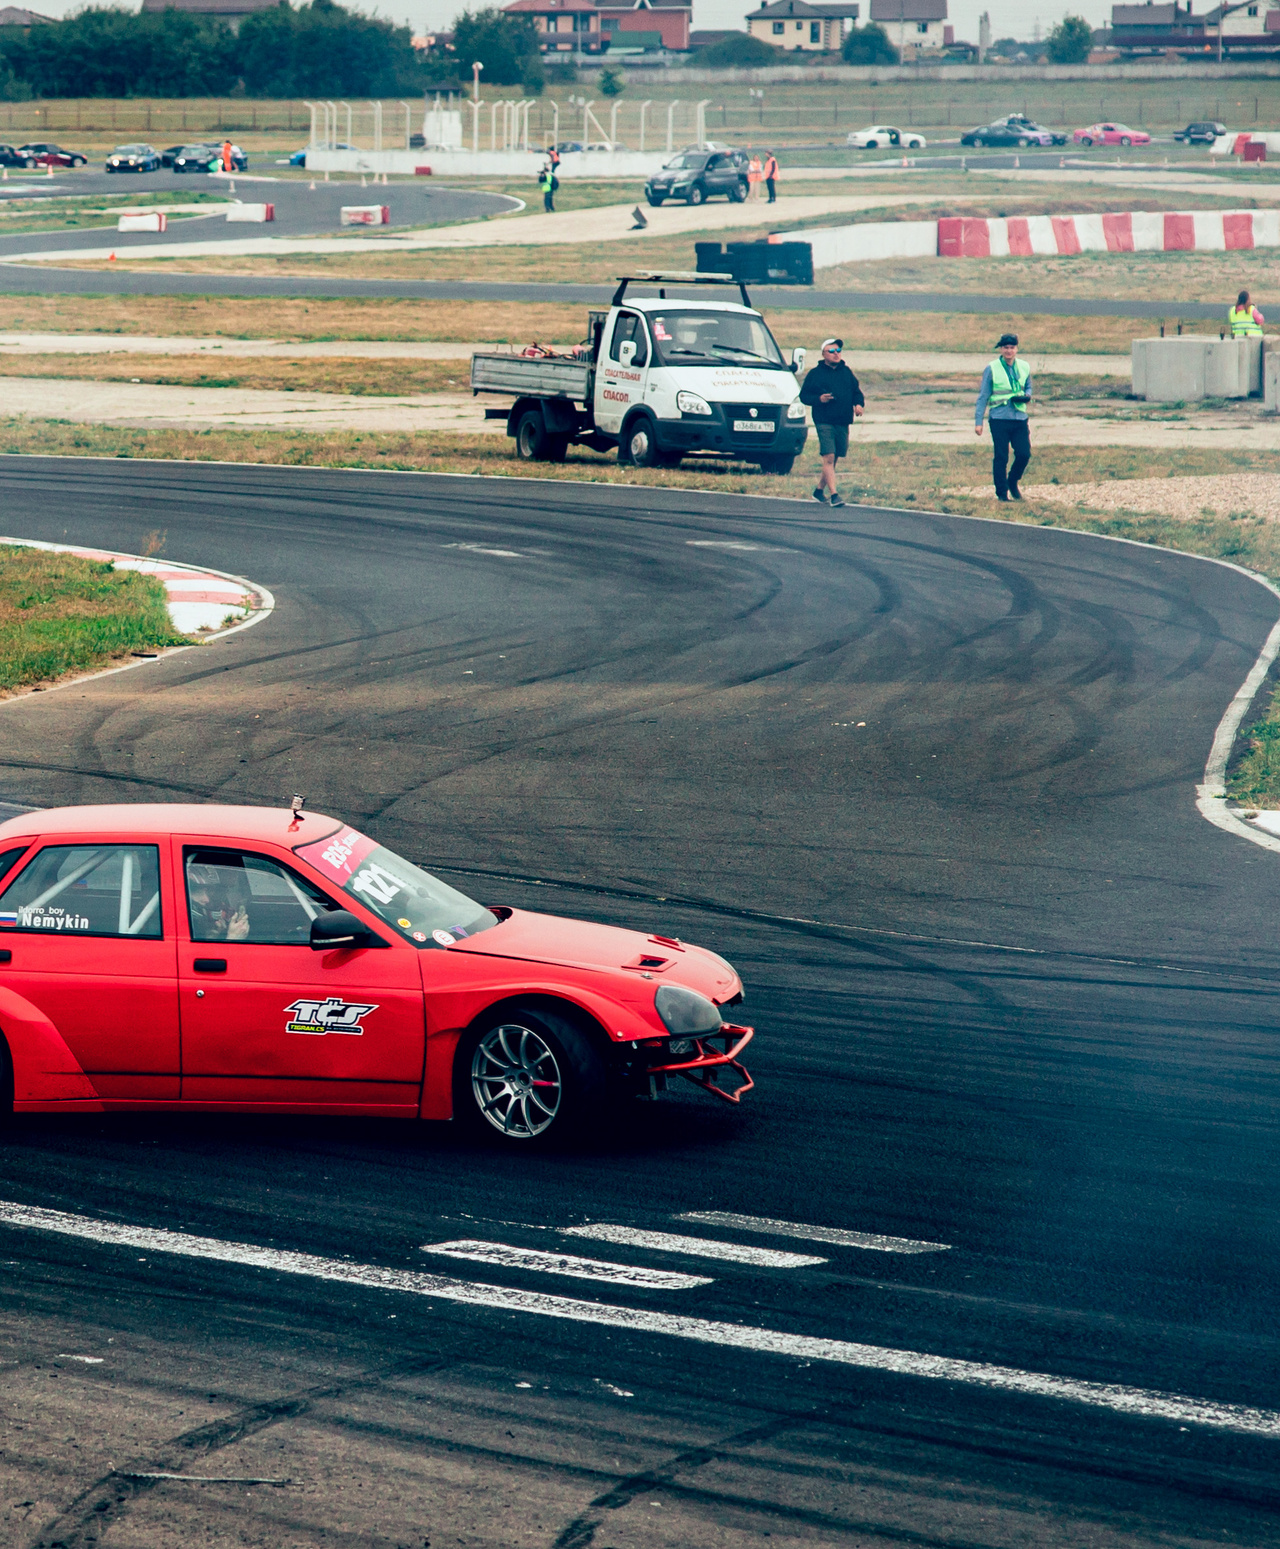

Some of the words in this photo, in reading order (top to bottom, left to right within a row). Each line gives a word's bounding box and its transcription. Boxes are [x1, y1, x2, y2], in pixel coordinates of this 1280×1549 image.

[321, 840, 353, 869] RDS
[352, 863, 407, 905] 121
[21, 914, 89, 930] Nemykin
[292, 1000, 370, 1026] TCS
[290, 1024, 325, 1032] TIGRAN.CS
